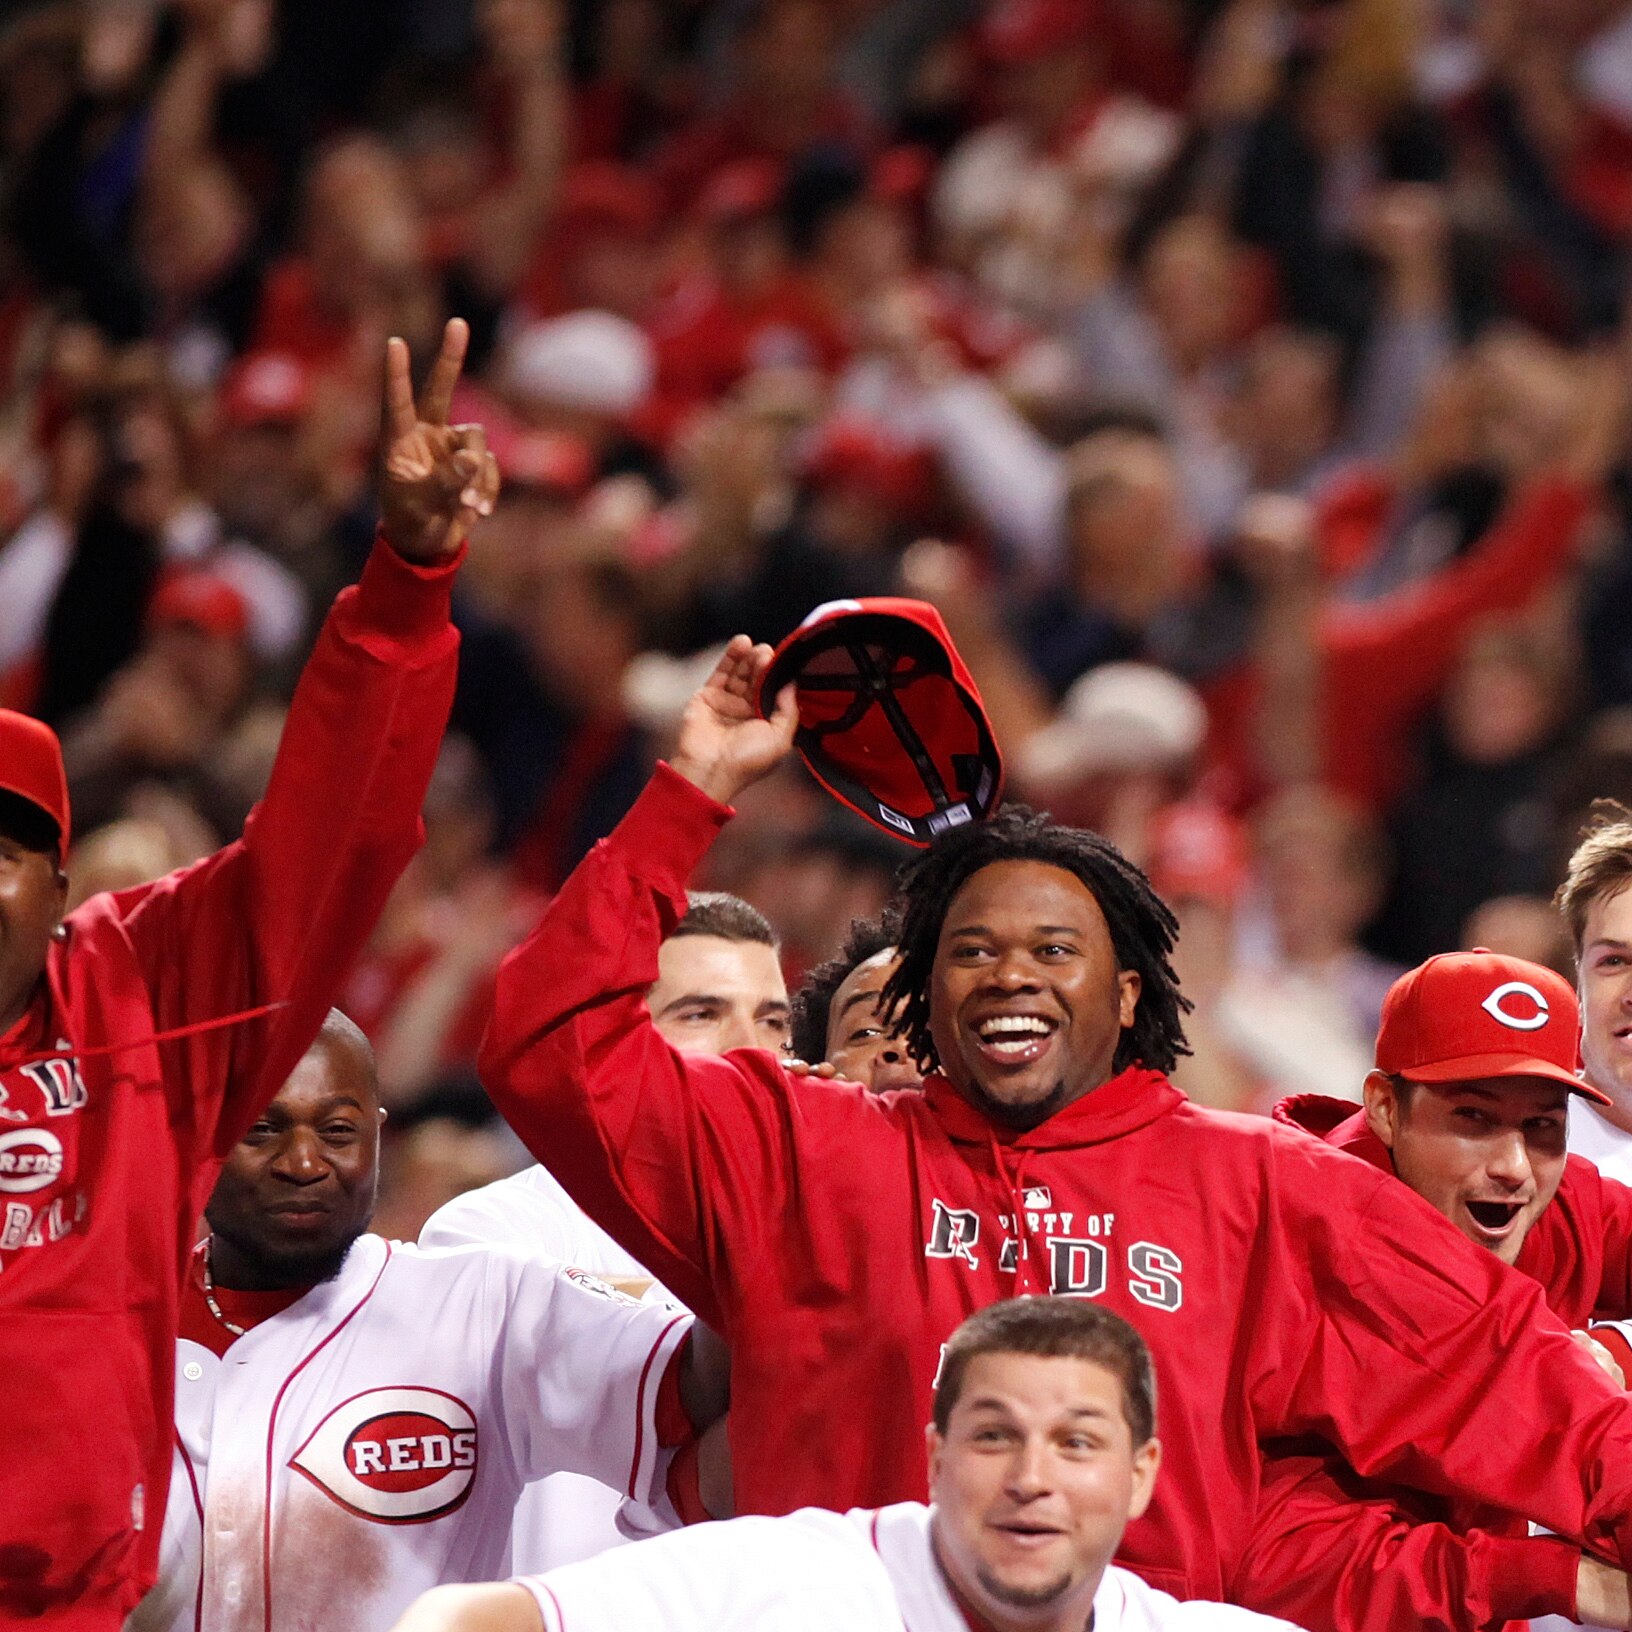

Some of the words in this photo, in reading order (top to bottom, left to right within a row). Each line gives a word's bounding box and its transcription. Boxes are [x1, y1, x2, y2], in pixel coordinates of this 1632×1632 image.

[0, 1152, 63, 1176] REDS
[1087, 1212, 1115, 1236] OF
[351, 1433, 476, 1476] REDS
